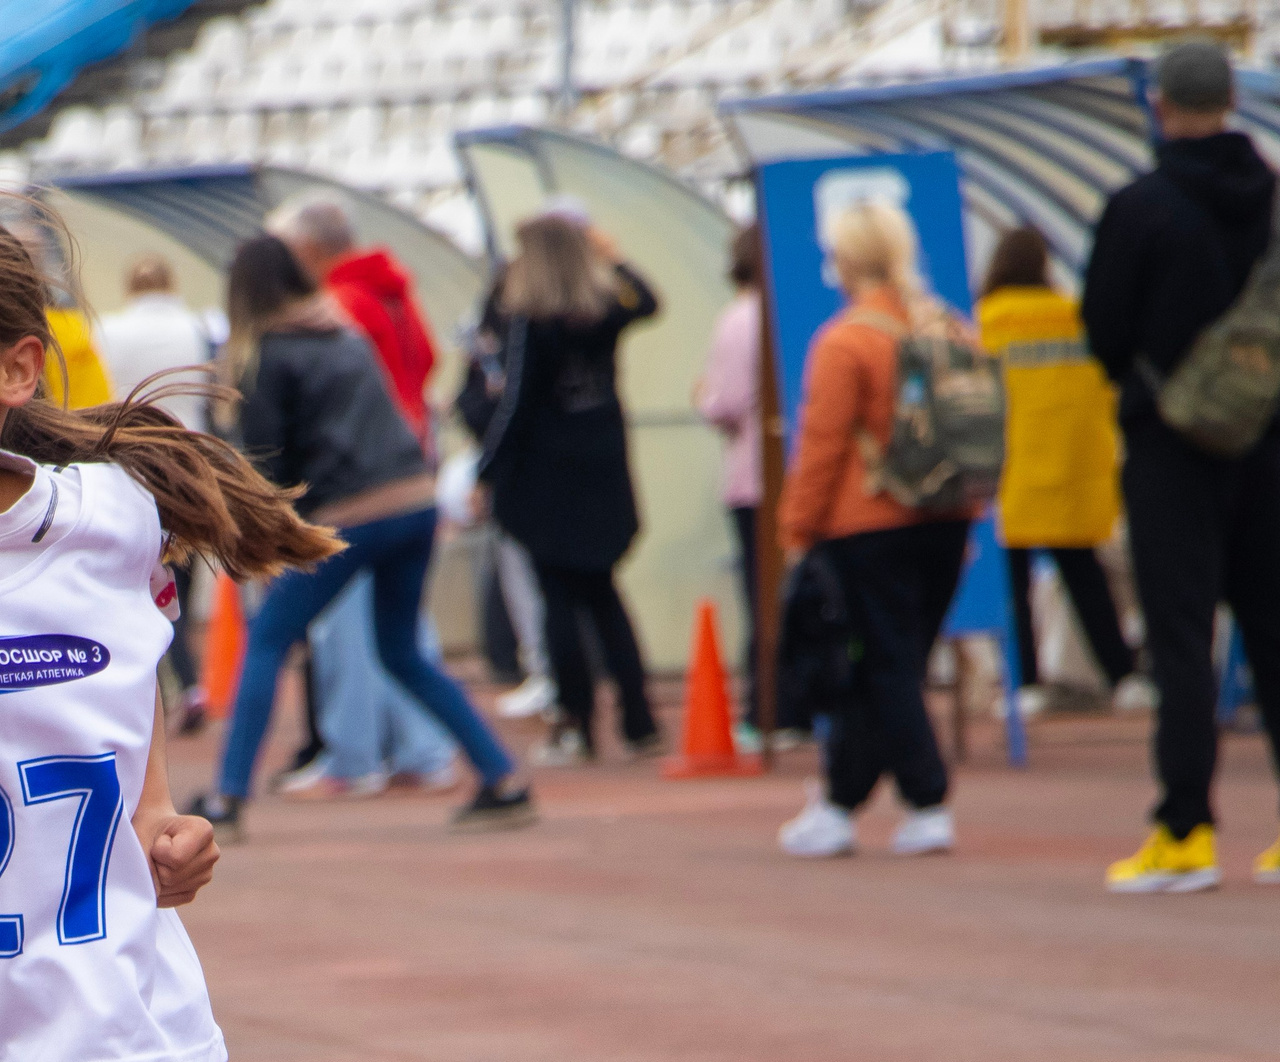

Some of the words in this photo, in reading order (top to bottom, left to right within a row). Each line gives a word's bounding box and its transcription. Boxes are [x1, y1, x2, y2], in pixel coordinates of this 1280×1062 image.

[67, 648, 88, 664] №
[91, 645, 102, 663] 3
[36, 667, 85, 680] АТЛЕТИКА
